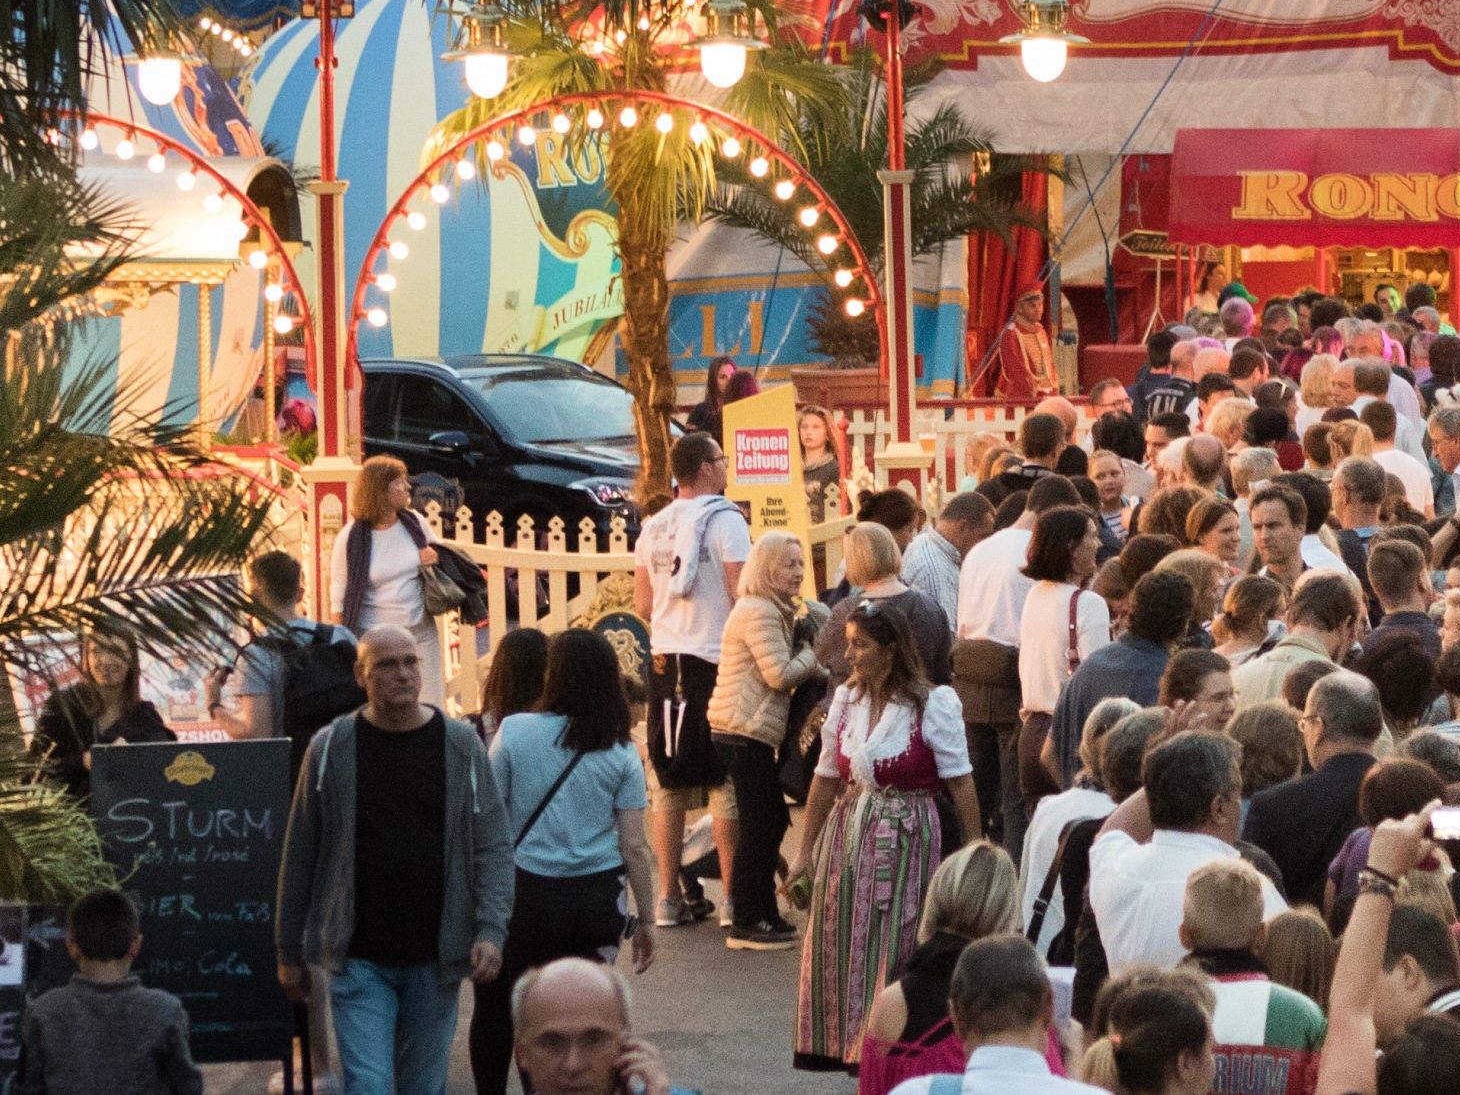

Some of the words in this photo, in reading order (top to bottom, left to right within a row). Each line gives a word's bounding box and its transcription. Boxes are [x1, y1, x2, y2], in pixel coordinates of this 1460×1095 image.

[736, 434, 787, 451] Kronen
[737, 453, 788, 470] Zeitung
[766, 497, 783, 505] Ihre
[107, 798, 272, 842] STURM
